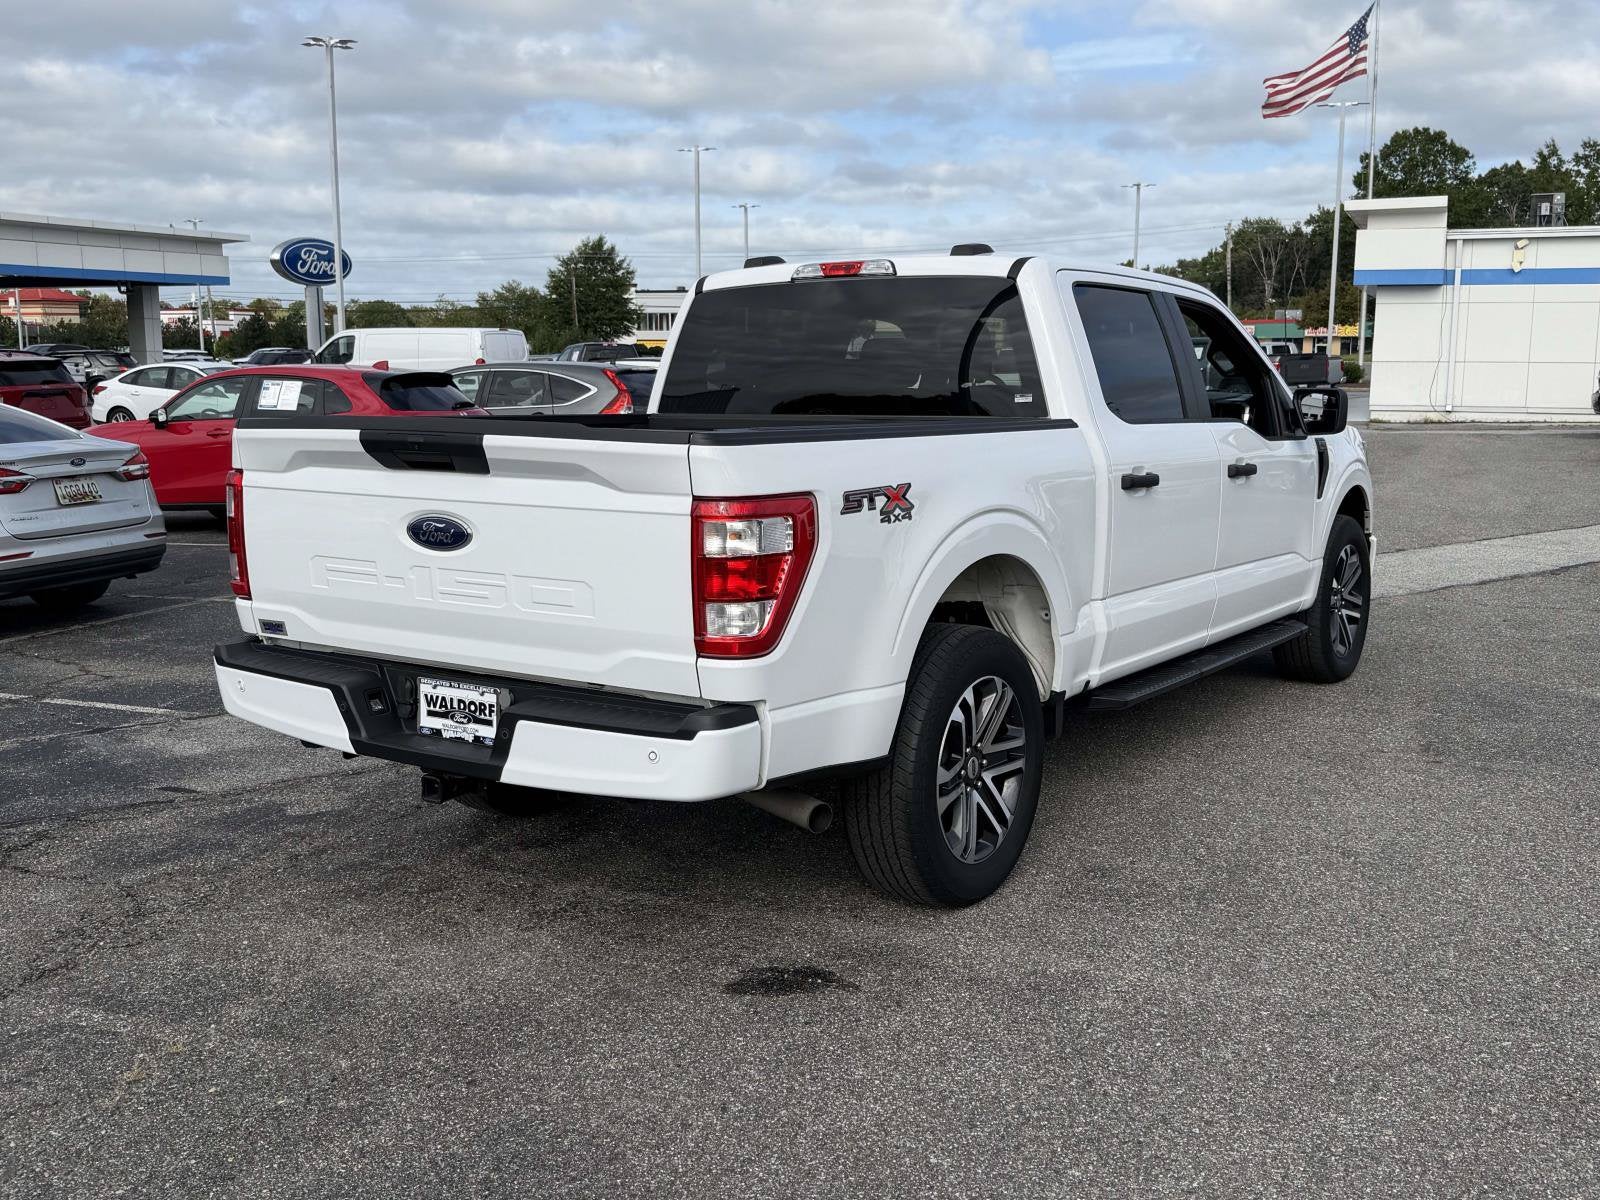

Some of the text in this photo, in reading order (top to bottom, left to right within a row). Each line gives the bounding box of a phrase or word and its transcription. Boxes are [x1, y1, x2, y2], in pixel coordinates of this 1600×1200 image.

[840, 482, 915, 516] STX
[419, 521, 455, 543] Ford
[309, 555, 597, 620] F-150
[420, 678, 450, 688] DEDICATED
[424, 693, 496, 718] WALDORF
[453, 713, 470, 724] Ford
